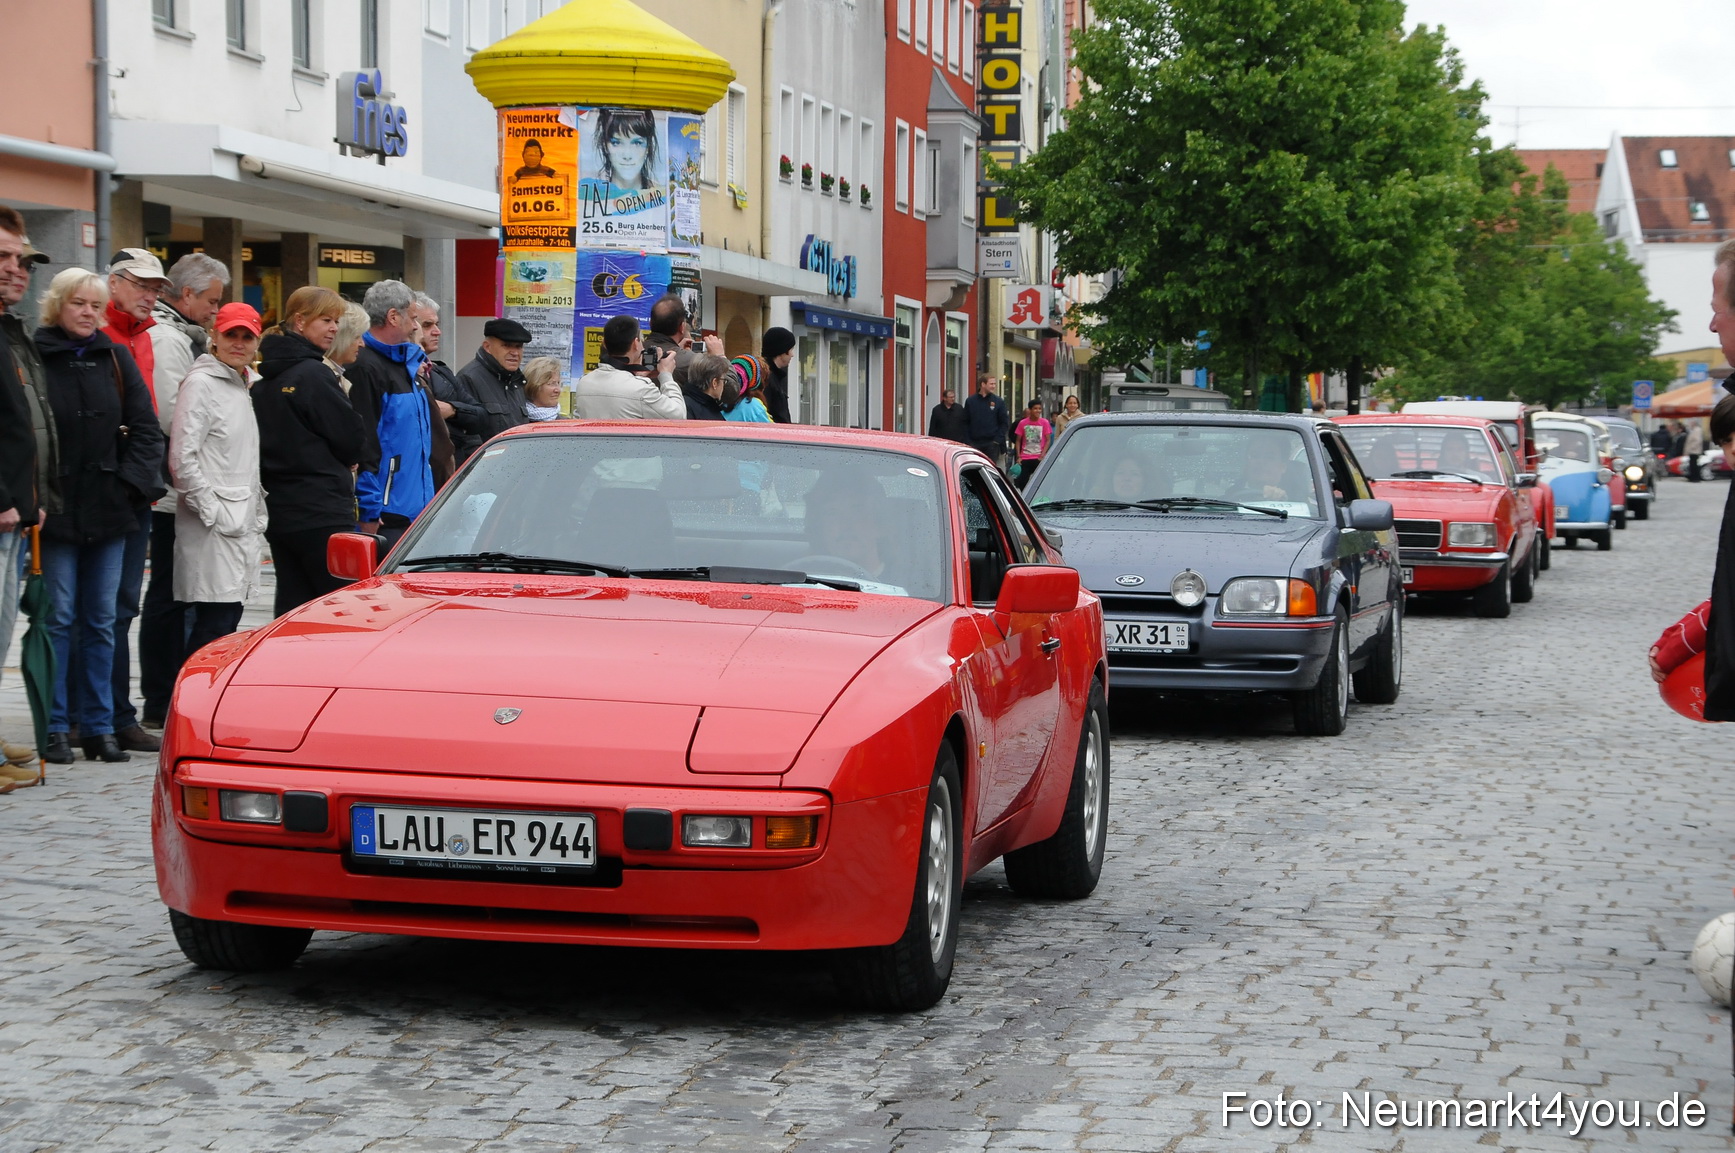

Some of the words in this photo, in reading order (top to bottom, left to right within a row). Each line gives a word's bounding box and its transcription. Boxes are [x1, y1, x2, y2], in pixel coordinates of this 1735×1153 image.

[353, 68, 408, 157] fries
[983, 12, 1020, 226] HOTEL
[507, 126, 574, 138] Flohmarkt
[511, 185, 563, 196] Samstag
[581, 181, 612, 218] ZAZ
[616, 194, 646, 214] OPEN
[649, 189, 665, 208] AIR
[512, 200, 560, 213] 01.06.
[506, 225, 569, 237] Volksfestplatz
[582, 221, 618, 233] 25.6.
[618, 222, 635, 230] Burg
[320, 248, 376, 265] FRIES
[985, 248, 1013, 258] Stern
[528, 295, 534, 304] 2.
[536, 295, 551, 304] Juni
[552, 296, 573, 306] 2013
[1115, 624, 1141, 645] XR
[1146, 625, 1172, 645] 31
[361, 835, 369, 845] D
[378, 813, 445, 853] LAU
[473, 817, 517, 856] ER
[527, 820, 592, 859] 944
